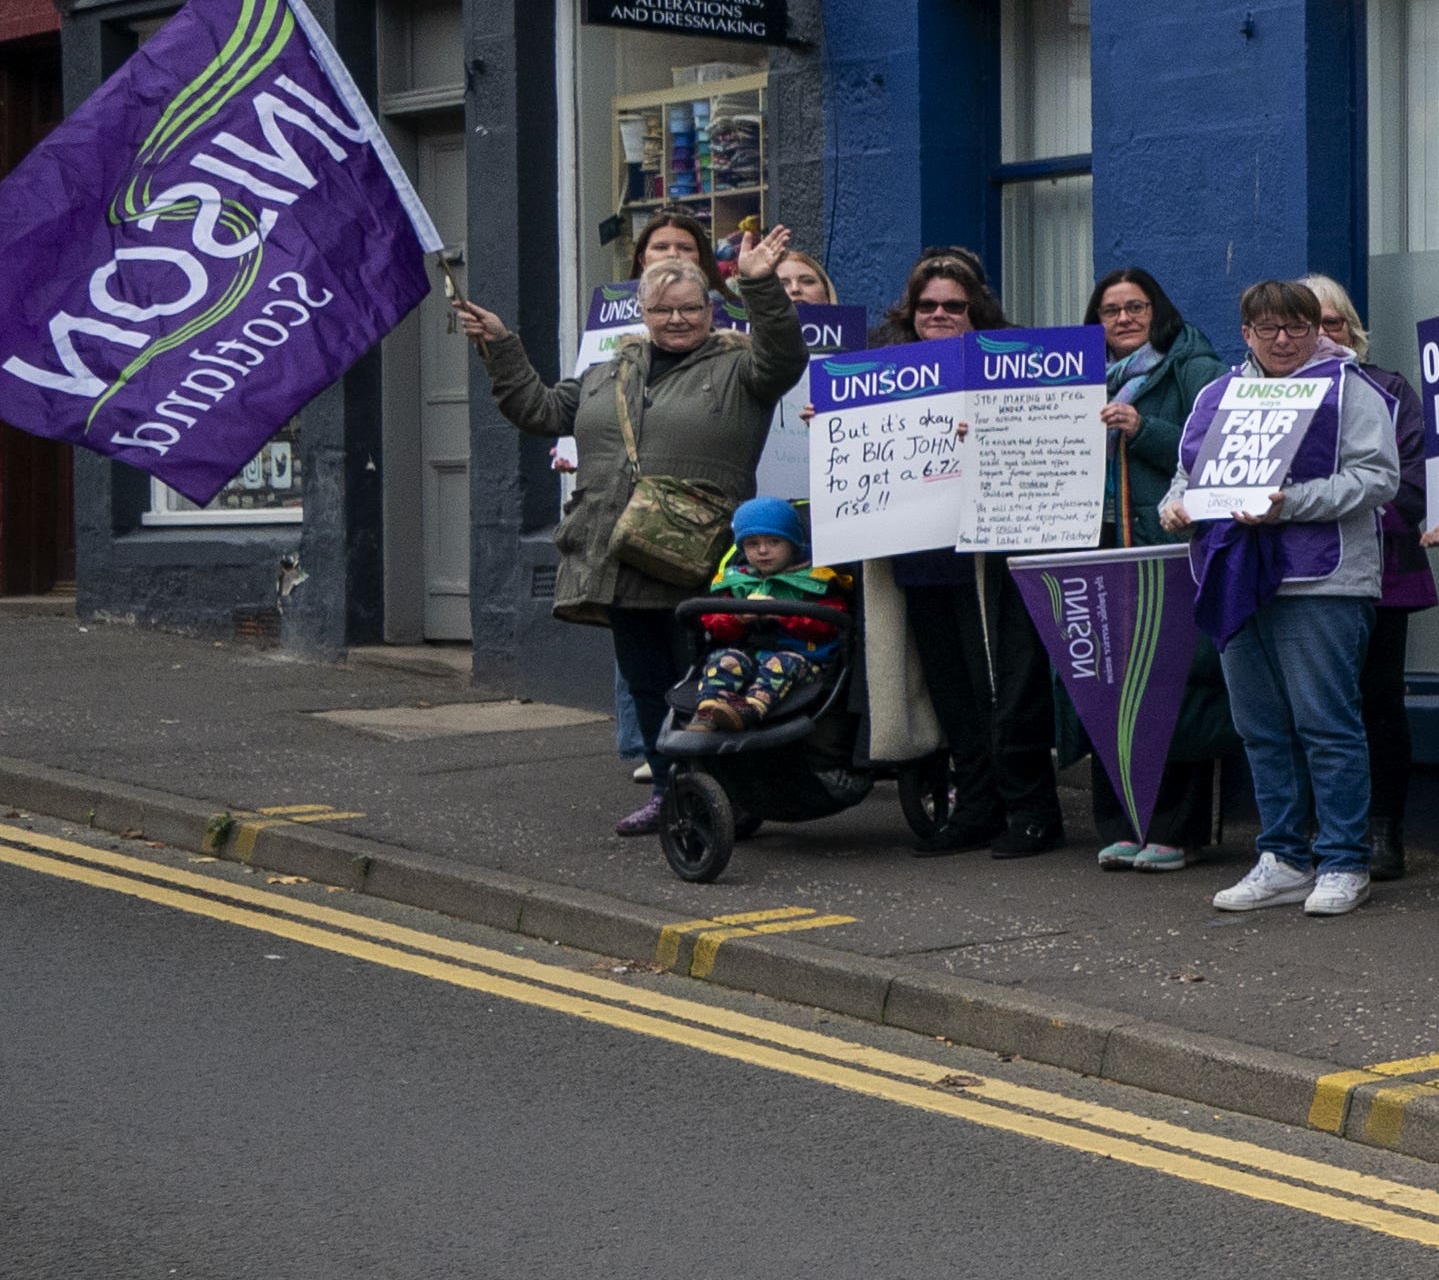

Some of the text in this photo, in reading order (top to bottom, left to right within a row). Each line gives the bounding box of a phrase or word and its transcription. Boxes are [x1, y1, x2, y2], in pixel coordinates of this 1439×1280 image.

[611, 5, 766, 37] AND DRESSMAKING
[984, 351, 1084, 381] UNISON
[831, 362, 940, 402] UNISON
[1236, 383, 1317, 399] UNISON
[828, 408, 955, 444] But it's okay
[1221, 410, 1299, 434] FAIR
[826, 430, 959, 475] for BIG JOHN
[1218, 434, 1284, 459] PAY
[827, 475, 848, 495] to
[858, 471, 890, 503] get
[900, 470, 918, 480] a
[1199, 459, 1282, 487] NOW
